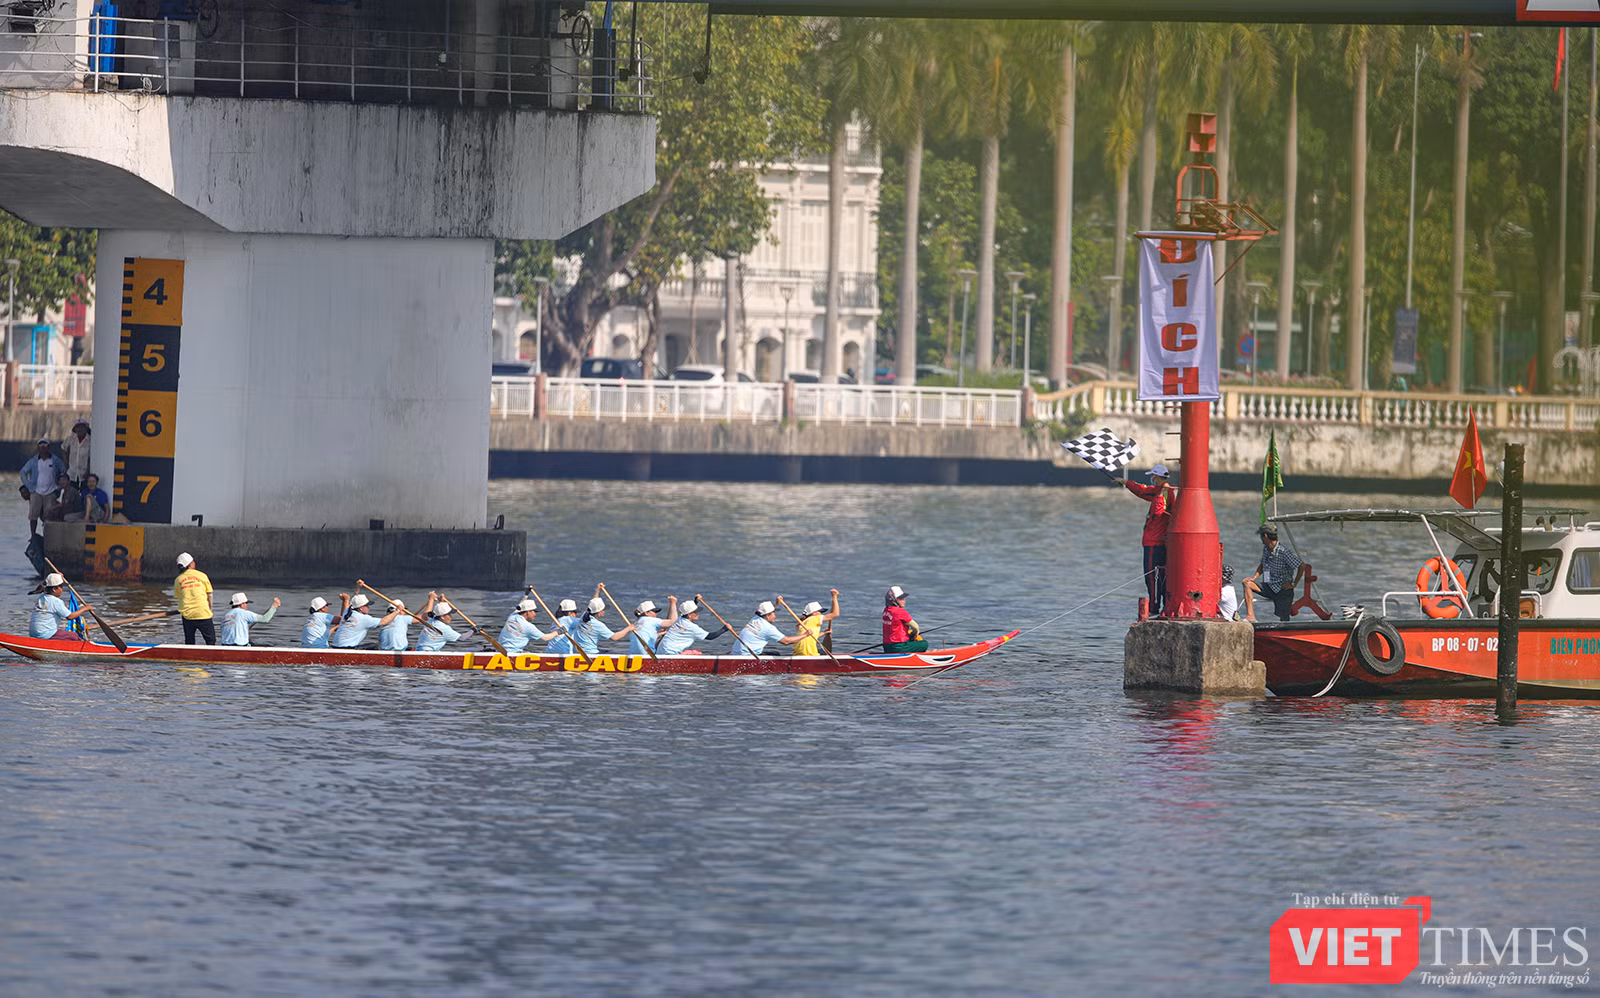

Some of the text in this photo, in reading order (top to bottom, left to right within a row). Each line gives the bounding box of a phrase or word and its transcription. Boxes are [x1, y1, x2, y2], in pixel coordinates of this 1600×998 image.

[143, 278, 168, 305] 4
[142, 344, 166, 372] 5
[139, 410, 162, 437] 6
[136, 475, 160, 504] 7
[107, 544, 129, 573] 8
[1431, 637, 1445, 652] BP
